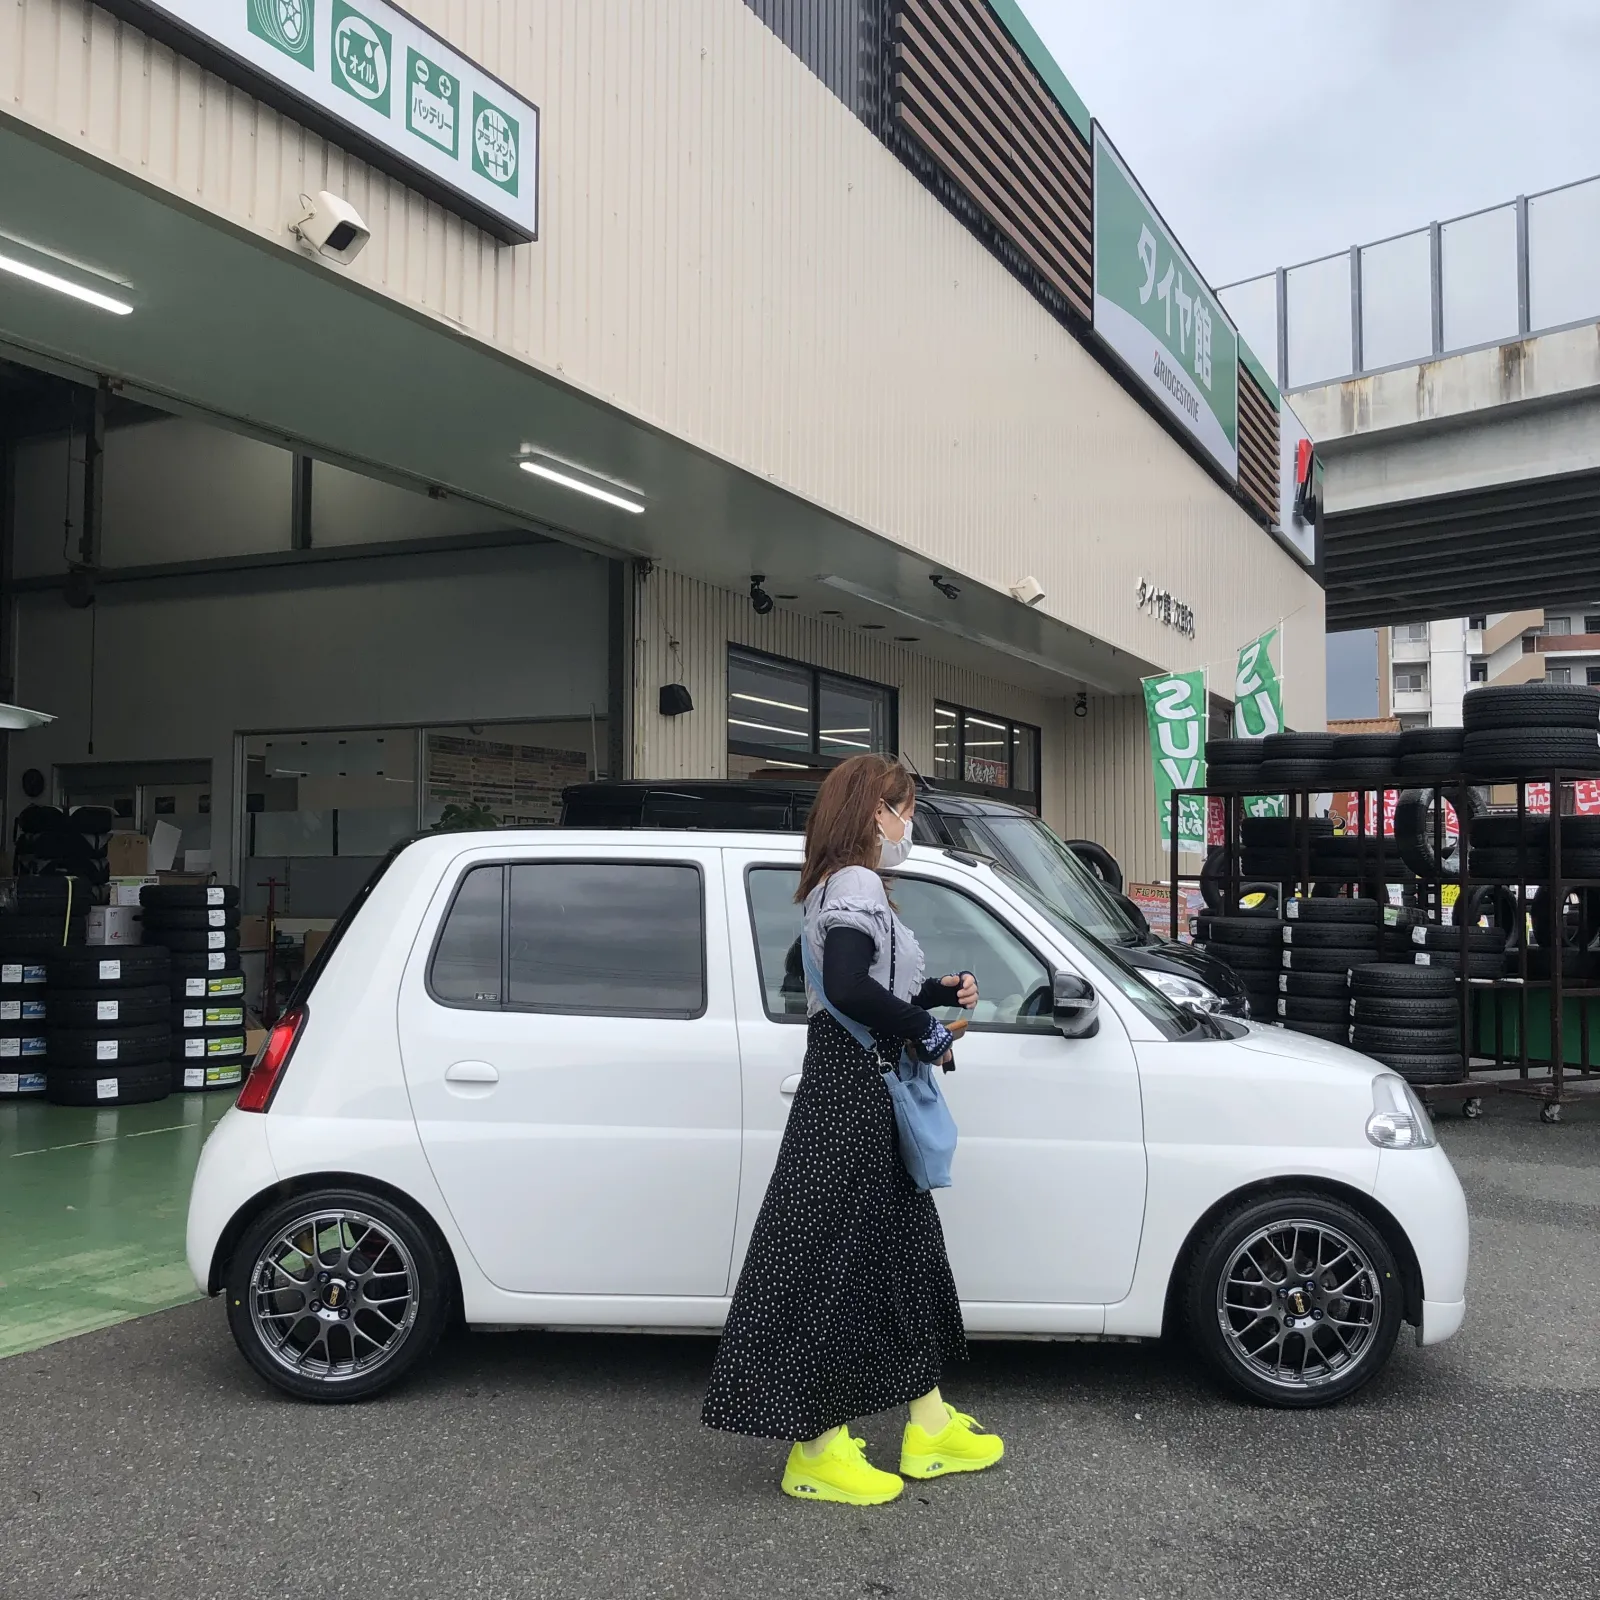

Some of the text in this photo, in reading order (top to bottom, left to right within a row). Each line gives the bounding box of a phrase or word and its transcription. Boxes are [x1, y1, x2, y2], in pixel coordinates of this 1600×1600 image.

[349, 54, 375, 85] オイル
[413, 97, 452, 132] バッテリー
[477, 128, 515, 162] アライメント
[1136, 222, 1213, 392] タイヤ館
[1152, 349, 1200, 424] BRIDGESTONE
